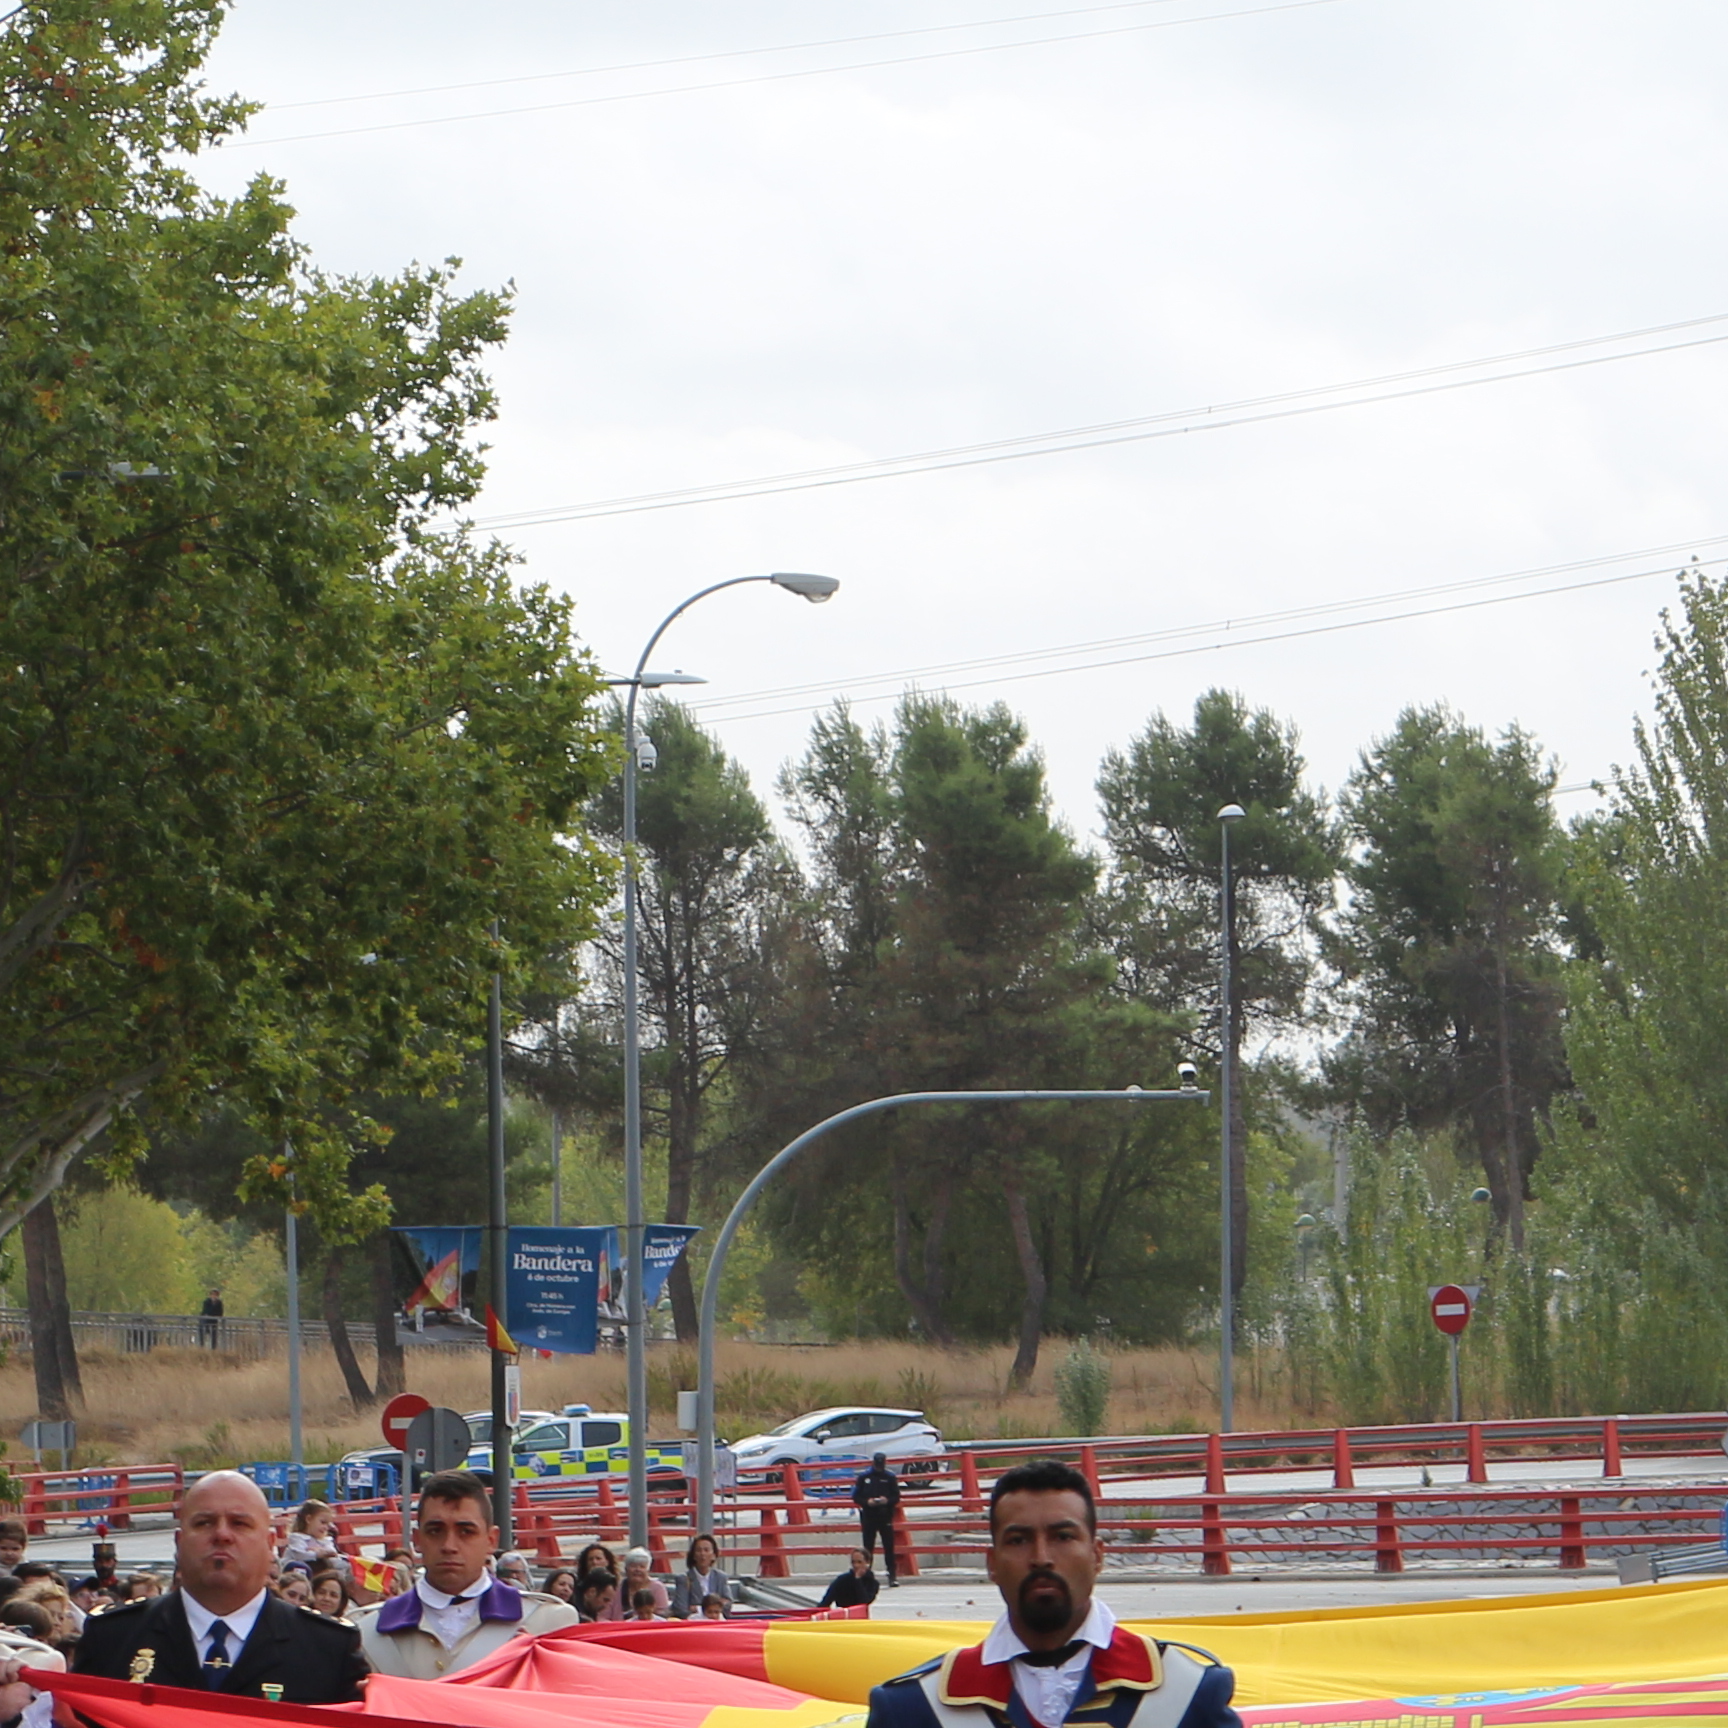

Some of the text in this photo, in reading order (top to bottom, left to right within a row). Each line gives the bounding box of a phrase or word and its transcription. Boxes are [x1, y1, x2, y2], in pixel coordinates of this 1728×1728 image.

[521, 1243, 566, 1254] Homenaje
[575, 1245, 585, 1254] la
[513, 1253, 594, 1272] Bandera
[546, 1274, 580, 1283] octubre
